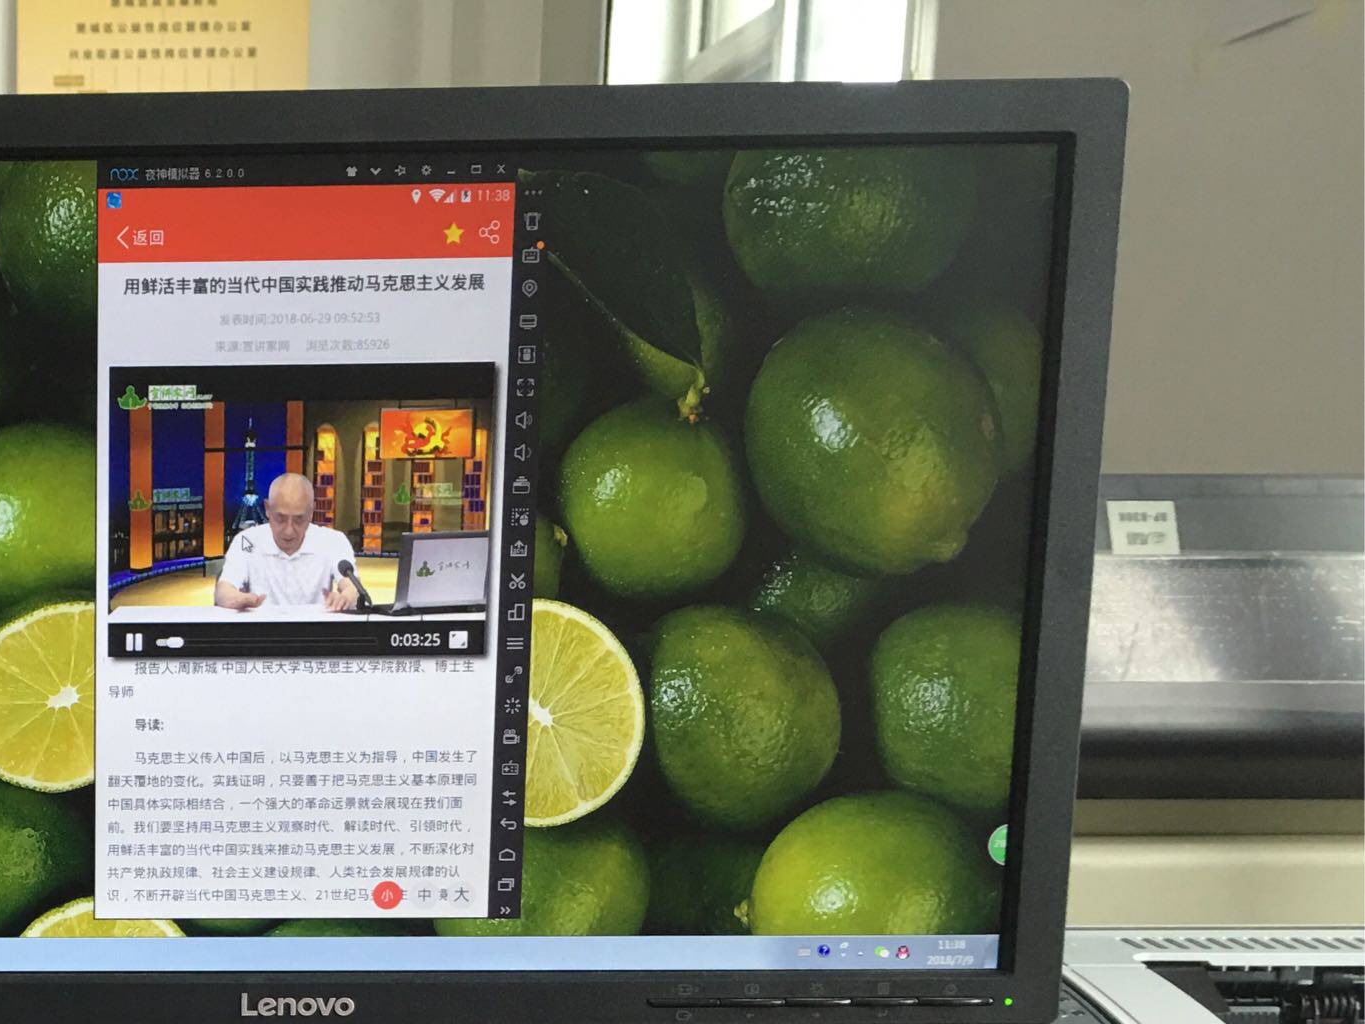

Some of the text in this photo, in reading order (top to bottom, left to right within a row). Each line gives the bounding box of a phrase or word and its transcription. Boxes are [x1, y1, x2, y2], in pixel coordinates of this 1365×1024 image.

[477, 188, 510, 202] 11:38
[133, 229, 165, 247] 返回
[123, 273, 485, 295] 用鲜活丰富的当代中国实践推动马克思主义发展
[333, 311, 381, 325] 09:52:53
[390, 633, 441, 648] 0:03:25
[108, 685, 134, 699] 导师
[134, 718, 165, 732] 导读:
[380, 889, 394, 902] 小
[417, 889, 432, 903] 中
[454, 887, 470, 903] 大
[937, 939, 966, 950] 11:38
[240, 992, 355, 1017] Lenovo
